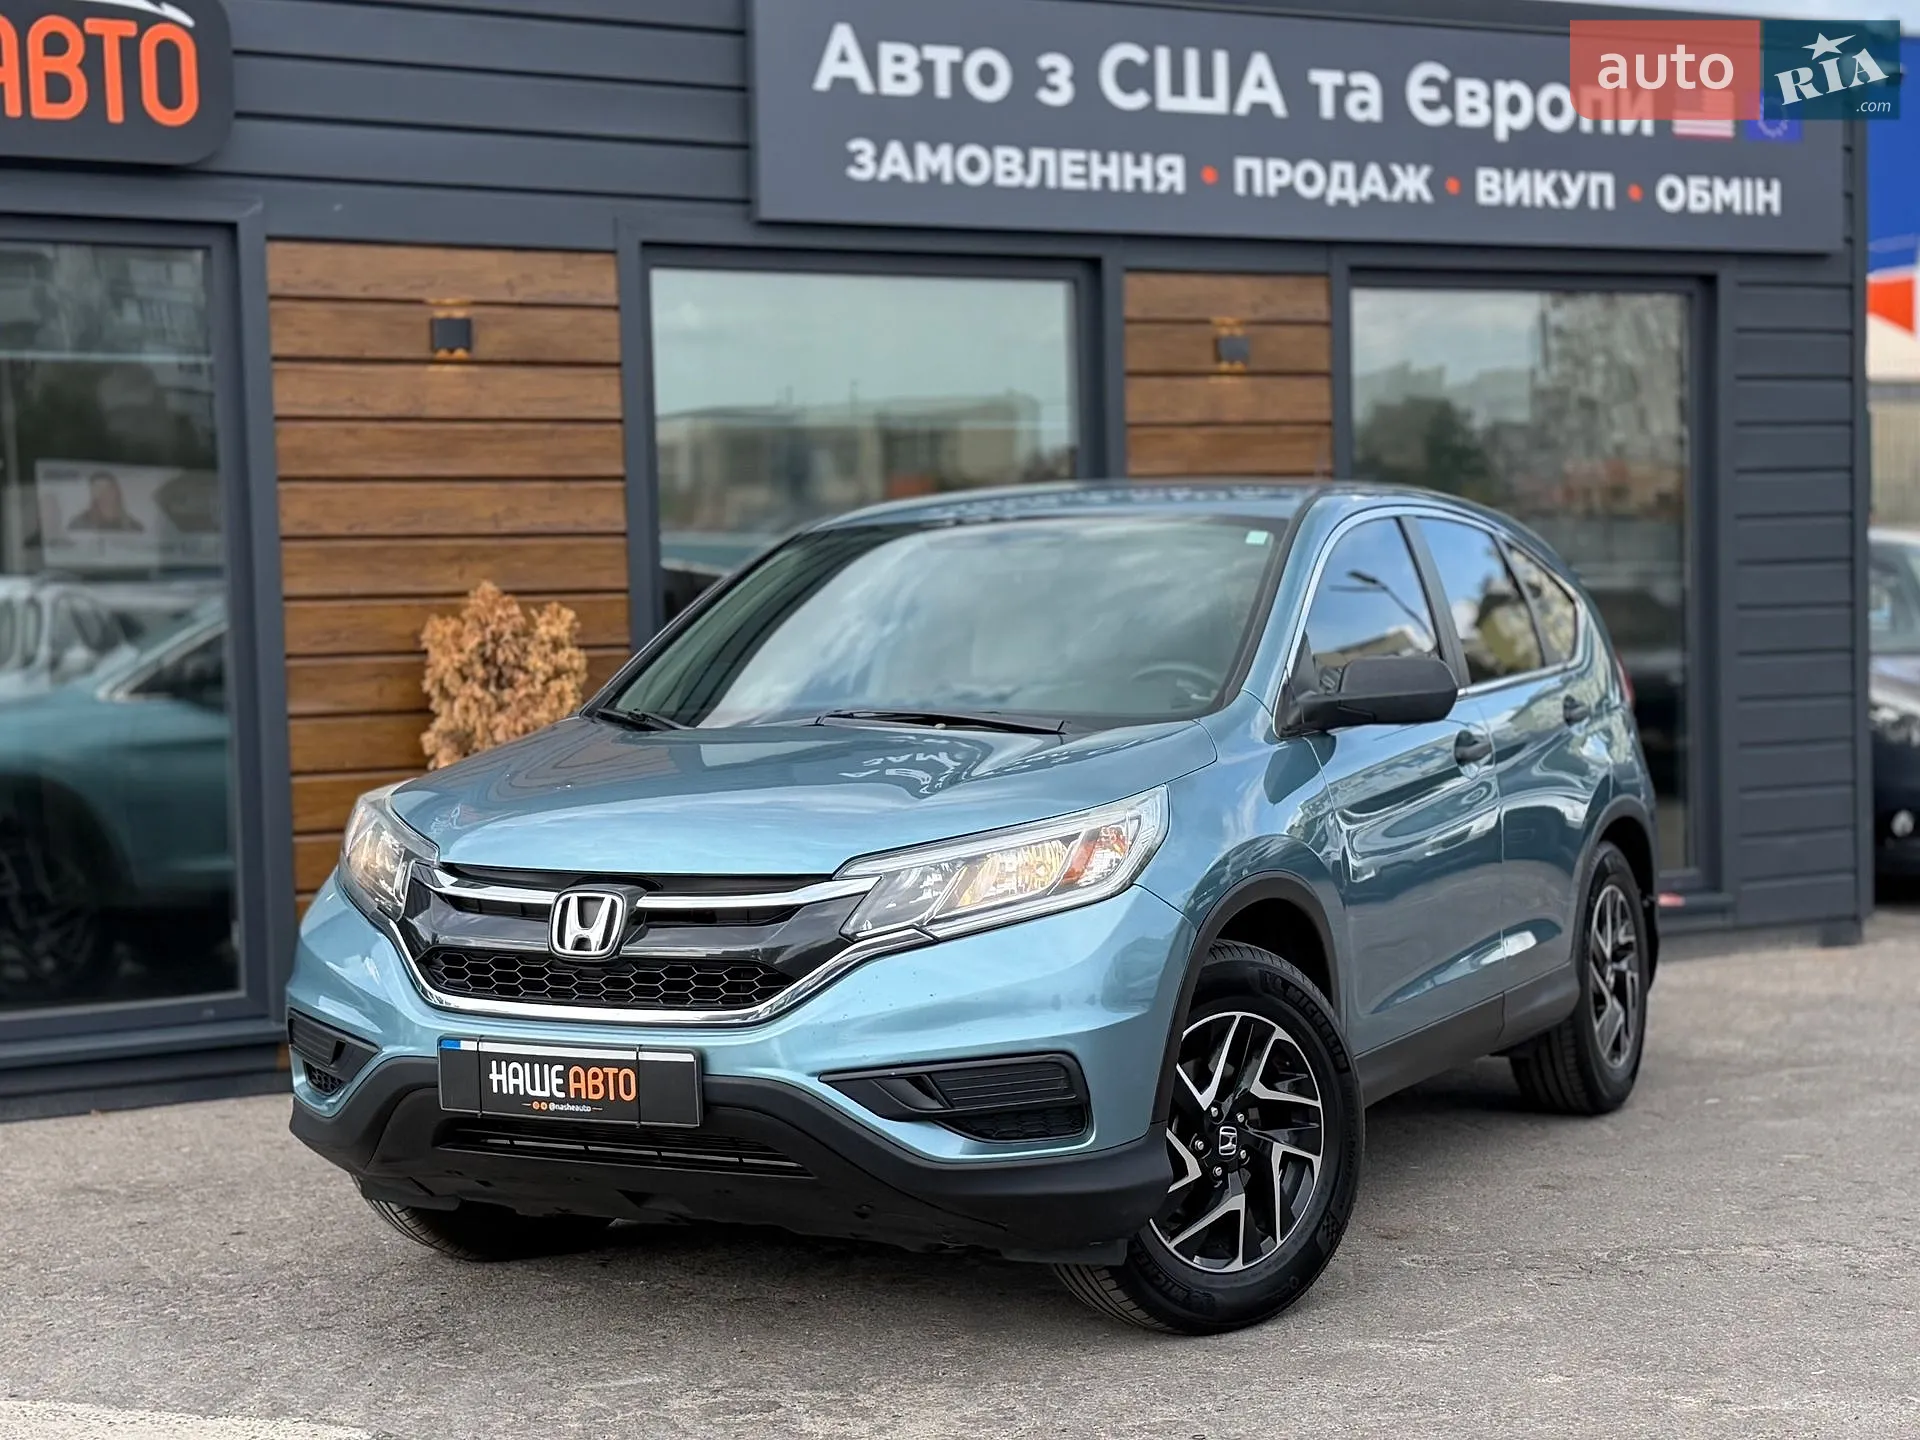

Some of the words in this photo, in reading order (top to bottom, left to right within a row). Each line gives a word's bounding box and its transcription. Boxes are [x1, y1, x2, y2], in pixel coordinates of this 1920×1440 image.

[813, 22, 1012, 102] Авто
[1036, 53, 1075, 106] з
[1099, 43, 1288, 118] США
[1308, 69, 1383, 123] та
[1405, 61, 1655, 141] Європи
[846, 138, 1186, 194] ЗАМОВЛЕННЯ
[1234, 158, 1434, 206] ПРОДАЖ
[1475, 168, 1615, 210] ВИКУП
[1656, 175, 1782, 216] ОБМІН
[489, 1060, 566, 1098] НАШЕ
[568, 1066, 637, 1101] АВТО
